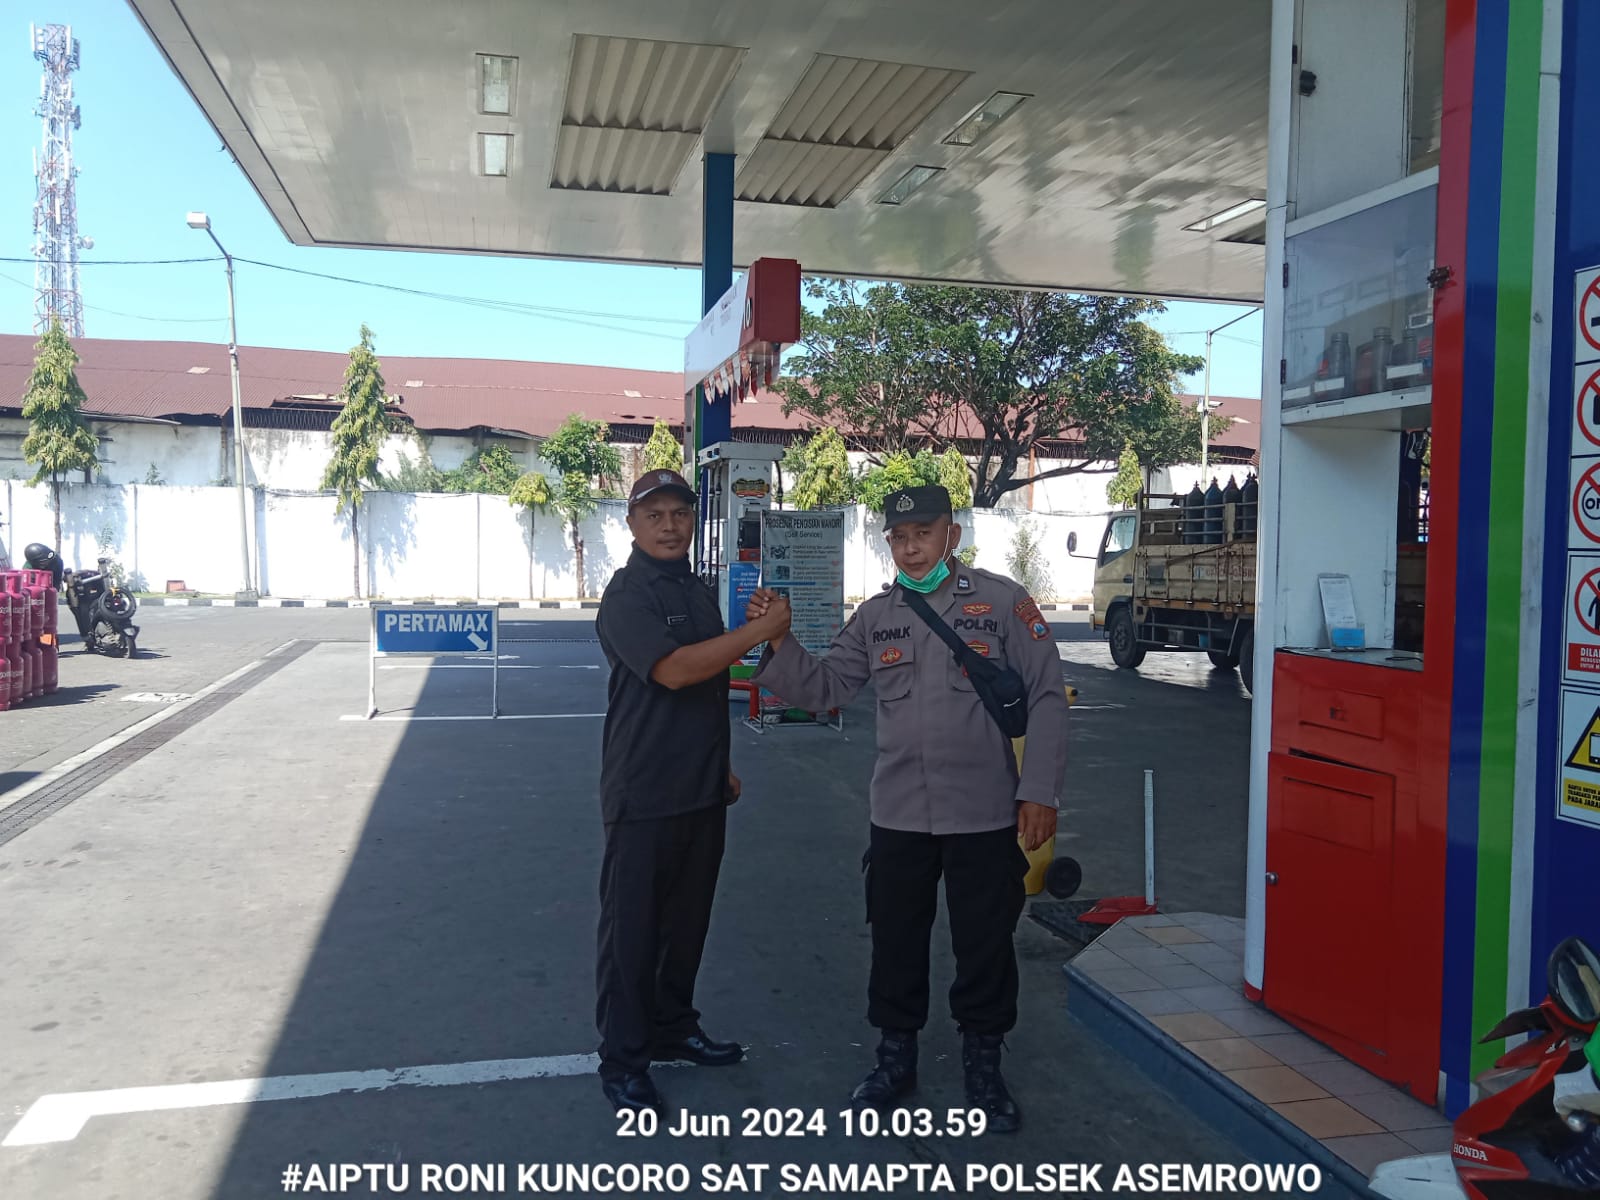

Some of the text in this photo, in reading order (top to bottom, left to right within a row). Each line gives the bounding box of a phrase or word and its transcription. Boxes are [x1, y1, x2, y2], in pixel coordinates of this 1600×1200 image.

[384, 613, 488, 632] PERTAMAX
[953, 618, 998, 633] POLRI
[1580, 647, 1600, 658] DILA
[1453, 1143, 1488, 1161] HONDA
